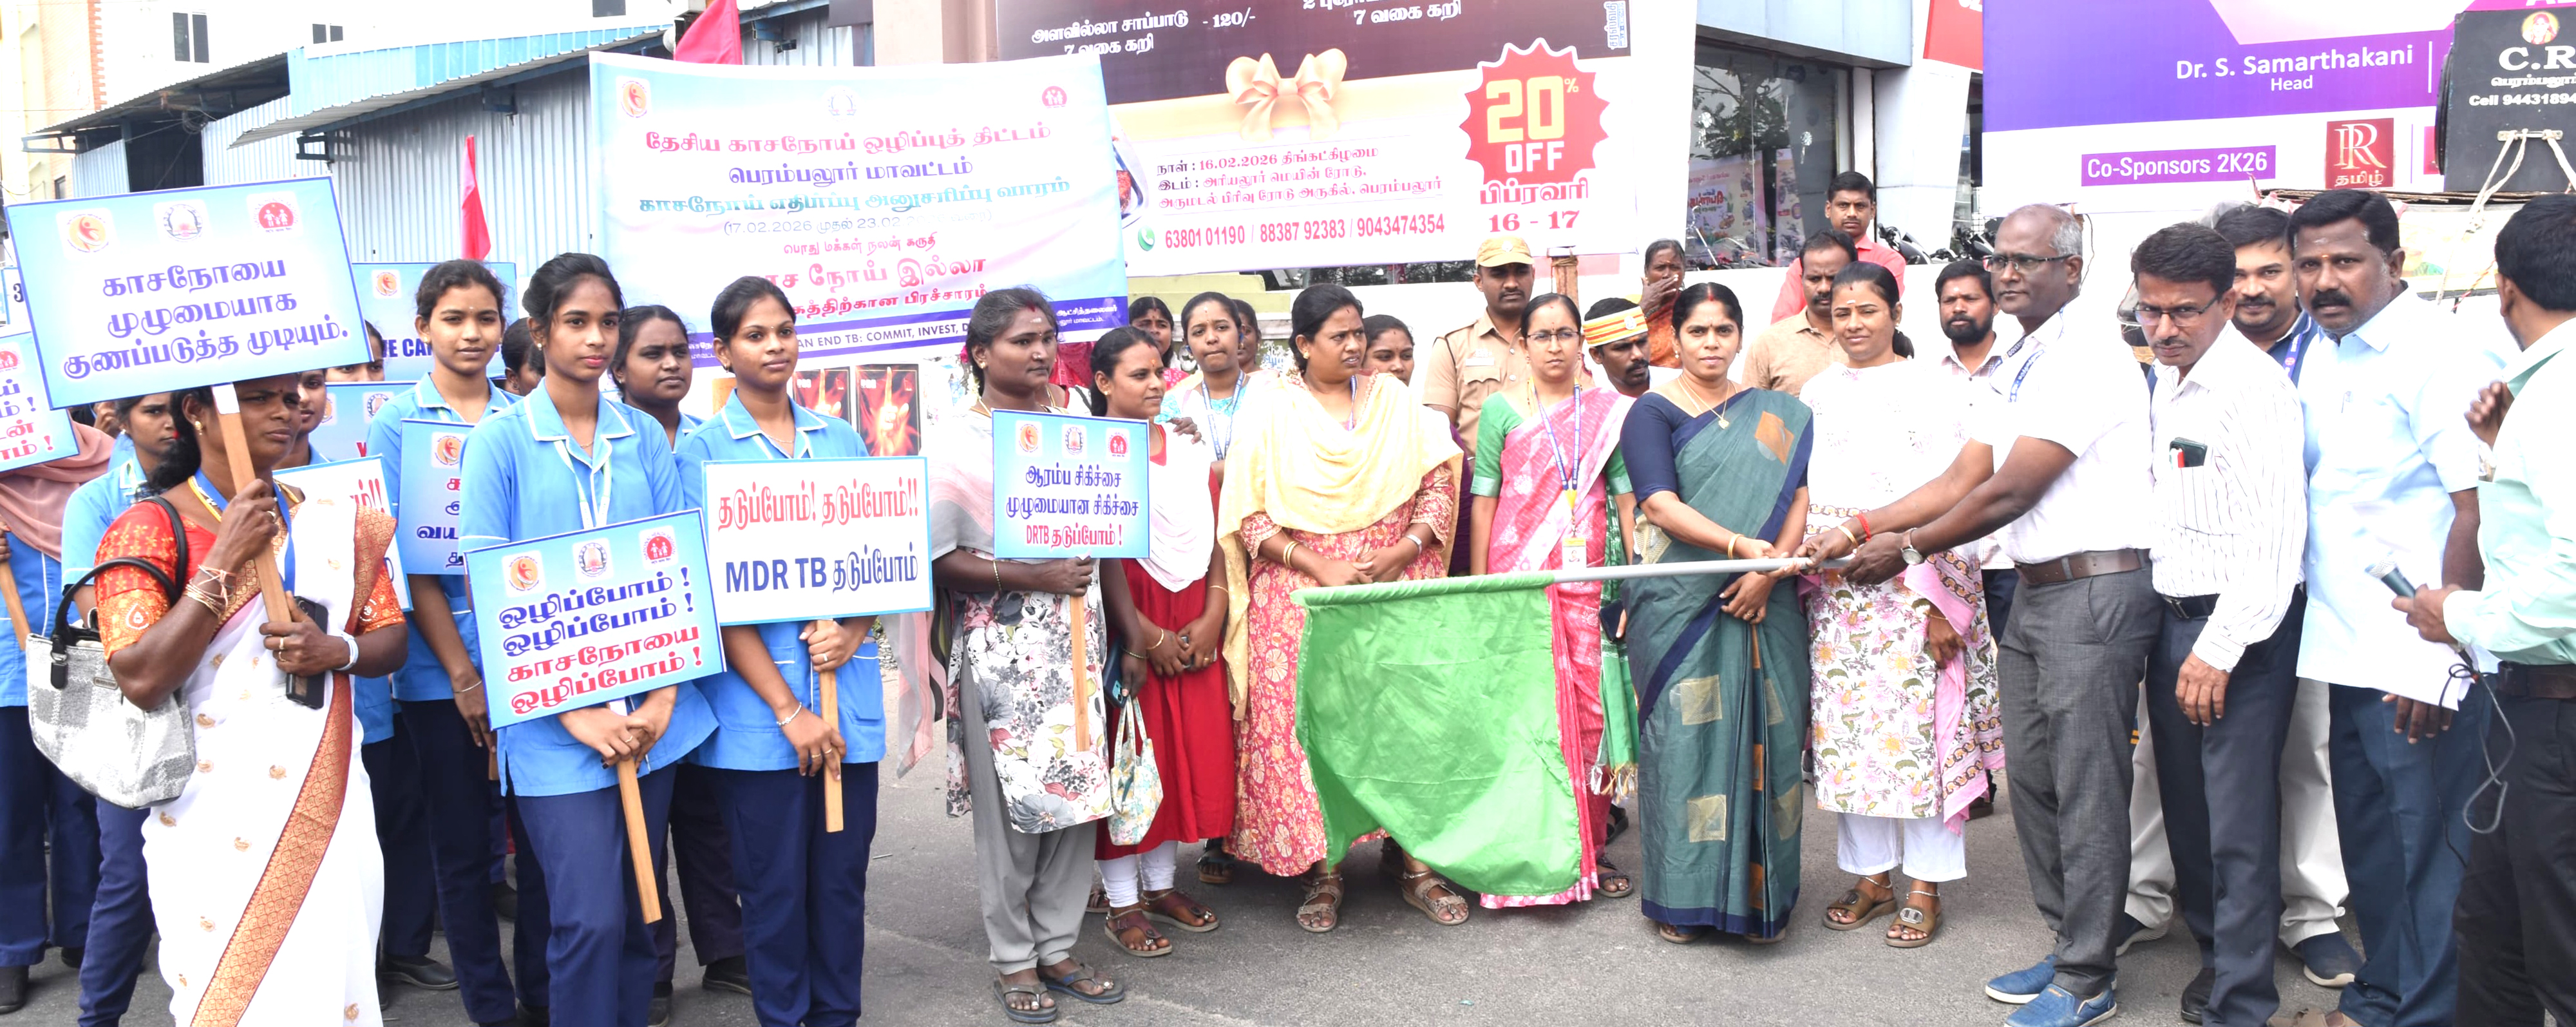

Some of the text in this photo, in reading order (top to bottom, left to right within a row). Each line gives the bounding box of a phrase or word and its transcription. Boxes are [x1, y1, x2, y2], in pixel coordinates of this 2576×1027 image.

[1031, 19, 1118, 44] அளவில்லா
[1122, 10, 1189, 32] சாப்பாடு
[1213, 7, 1256, 28] 120/-
[1354, 0, 1461, 24] 7 வகை கறி
[1078, 41, 1122, 55] வகை
[1125, 33, 1155, 55] கறி
[2177, 44, 2413, 79] Dr. S. Samarthakani
[2271, 75, 2313, 91] Head
[2469, 95, 2499, 106] Cell
[646, 121, 1050, 155] தேசிய காசநோய் ஒழிப்புத் திட்டம்
[729, 156, 972, 187] பெரம்பலூர் மாவட்டம்
[1157, 160, 1188, 177] நாள்
[1200, 153, 1278, 171] 16.02.2026
[1281, 147, 1379, 166] திங்கட்கிழமை
[1506, 140, 1564, 173] OFF
[2087, 151, 2268, 180] Co-Sponsors 2K26
[1158, 177, 1191, 191] இடம்
[1202, 171, 1265, 188] அரியலூர்
[1270, 167, 1320, 183] மெயின்
[1159, 192, 1218, 210] அருமடல்
[1222, 192, 1255, 205] பிரிவு
[1258, 188, 1294, 202] ரோடு
[1359, 175, 1443, 195] பெரம்பலூர்
[1480, 177, 1589, 205] பிப்ரவரி
[2334, 169, 2383, 187] தமிழ்
[639, 176, 1070, 218] காசநோய் எதிர்ப்பு அனுசரிப்பு வாரம்
[724, 221, 812, 236] (17.02.2026
[817, 218, 853, 234] முதல்
[1164, 227, 1202, 249] 63801
[1205, 224, 1245, 246] 01190
[1260, 222, 1300, 243] 88387
[1303, 219, 1345, 240] 92383
[1357, 213, 1445, 238] 9043474354
[1489, 213, 1520, 233] 16
[1548, 210, 1580, 229] 17
[784, 231, 938, 256] பொது மக்கள் நலன் கருதி
[103, 259, 286, 297] காசநோயை
[809, 260, 887, 293] நோய்
[897, 254, 986, 288] இல்லா
[108, 291, 298, 338] முழுமையாக
[793, 296, 898, 319] கத்திற்கான
[64, 314, 349, 379] குணப்படுத்த முடியும்.
[797, 338, 813, 349] AN
[819, 336, 841, 347] END
[847, 332, 863, 343] TB:
[867, 327, 914, 341] COMMIT,
[918, 324, 958, 336] INVEST,
[1026, 462, 1121, 487] ஆரம்ப சிகிச்சை
[718, 477, 918, 532] தடுப்போம்! தடுப்போம்!!
[1006, 494, 1139, 519] முழுமையான சிகிச்சை
[1027, 525, 1049, 544] DRTB
[1051, 522, 1115, 549] தடுப்போம்
[726, 541, 918, 595] MDR TB தடுப்போம்
[498, 571, 674, 629] ஒழிப்போம்
[503, 597, 677, 657] ஒழிப்போம்
[507, 626, 699, 682] காசநோயை
[511, 651, 685, 714] ஒழிப்போம்
